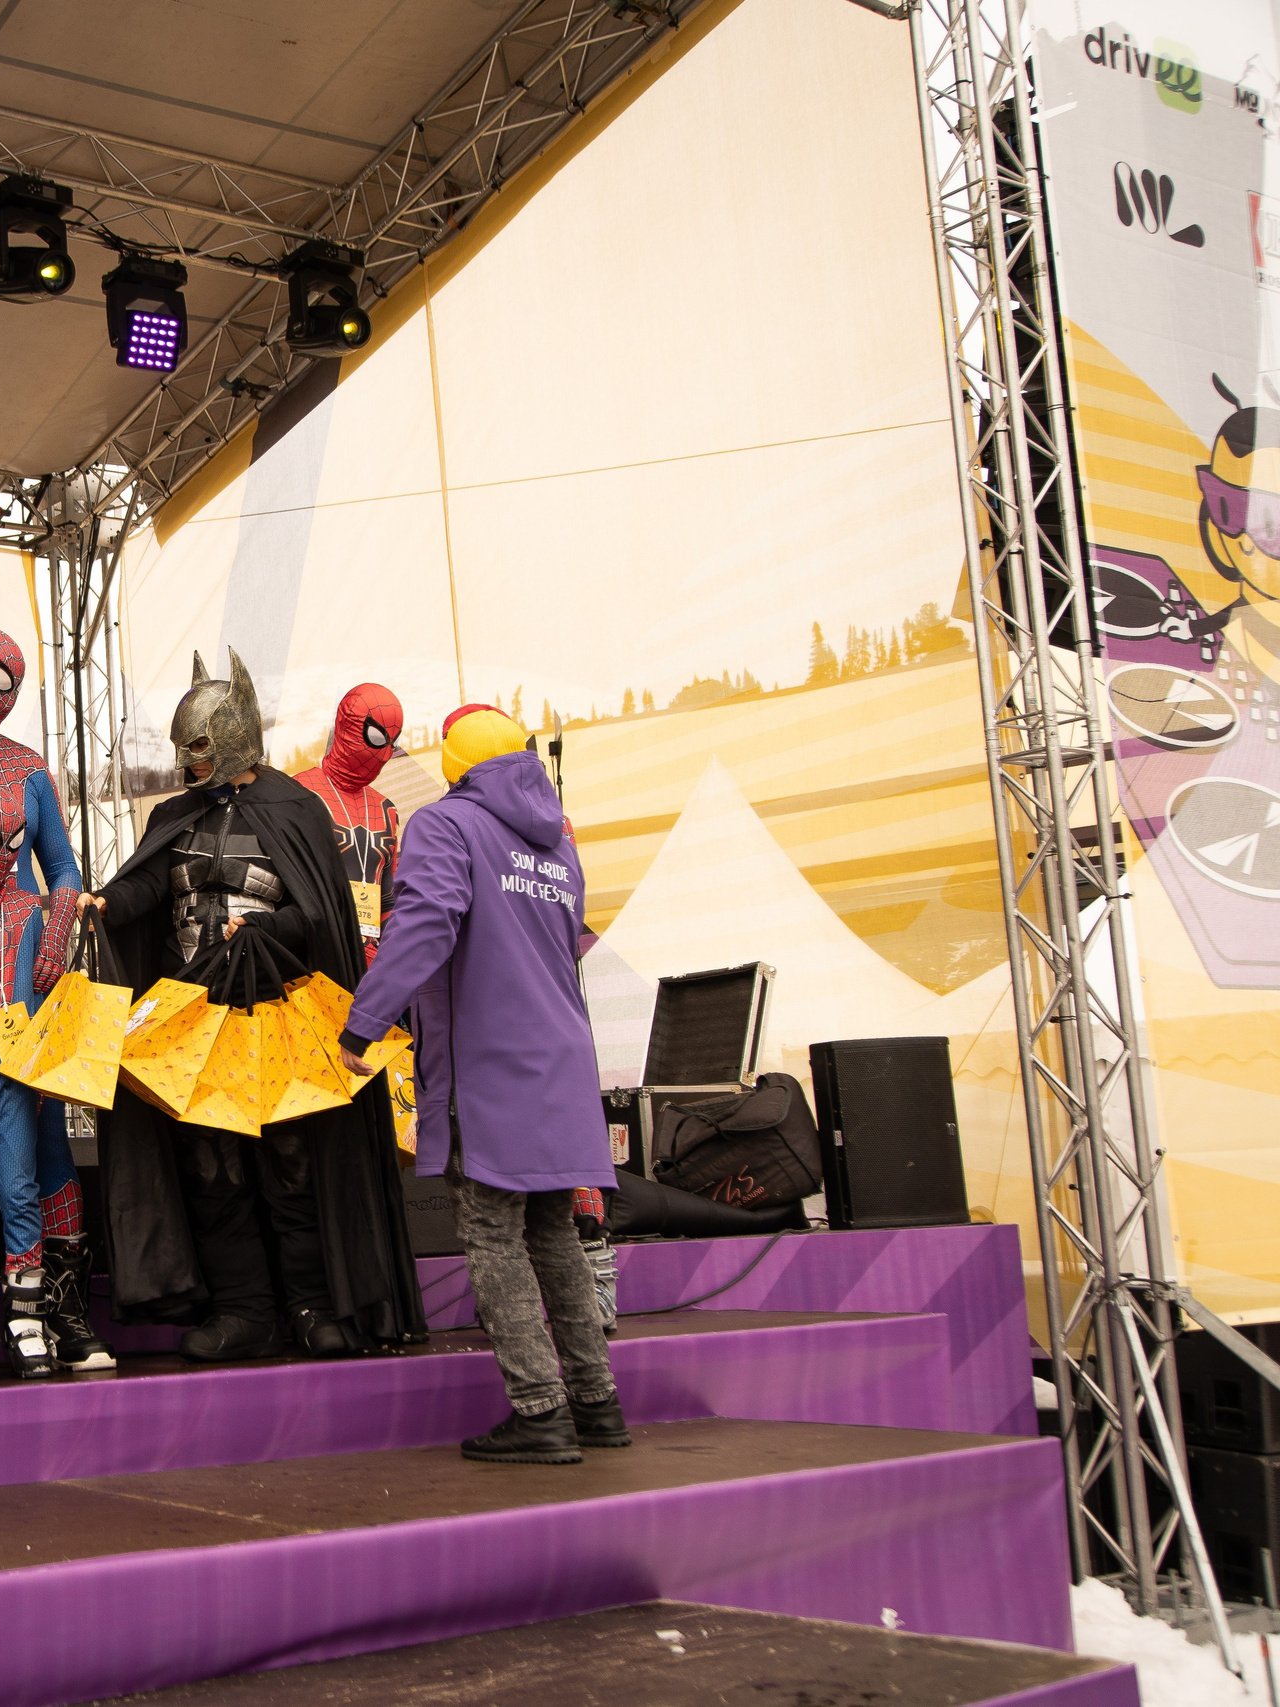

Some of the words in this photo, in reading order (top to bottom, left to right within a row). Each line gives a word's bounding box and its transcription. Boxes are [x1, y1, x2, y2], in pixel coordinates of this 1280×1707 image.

[510, 851, 535, 872] SUN
[544, 862, 569, 882] RIDE
[358, 911, 372, 919] 378
[2, 1029, 25, 1041] билайн
[742, 1186, 765, 1204] SOUND
